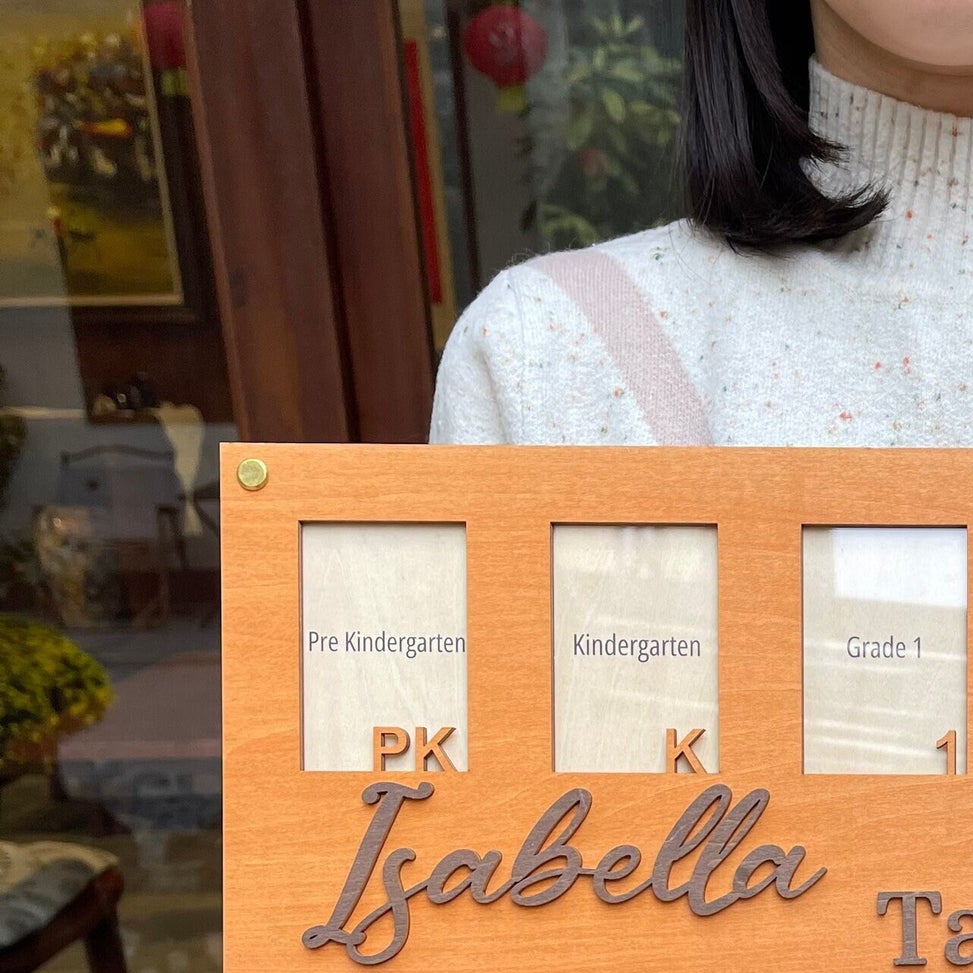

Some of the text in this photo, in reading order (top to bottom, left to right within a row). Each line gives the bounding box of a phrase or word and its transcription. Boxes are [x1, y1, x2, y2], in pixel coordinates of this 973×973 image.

[308, 631, 466, 658] Pre Kindergarten
[573, 632, 701, 663] Kindergarten
[847, 636, 922, 659] Grade 1
[372, 726, 456, 771] PK
[665, 728, 707, 773] K
[936, 730, 957, 774] 1
[301, 782, 827, 966] Isabella
